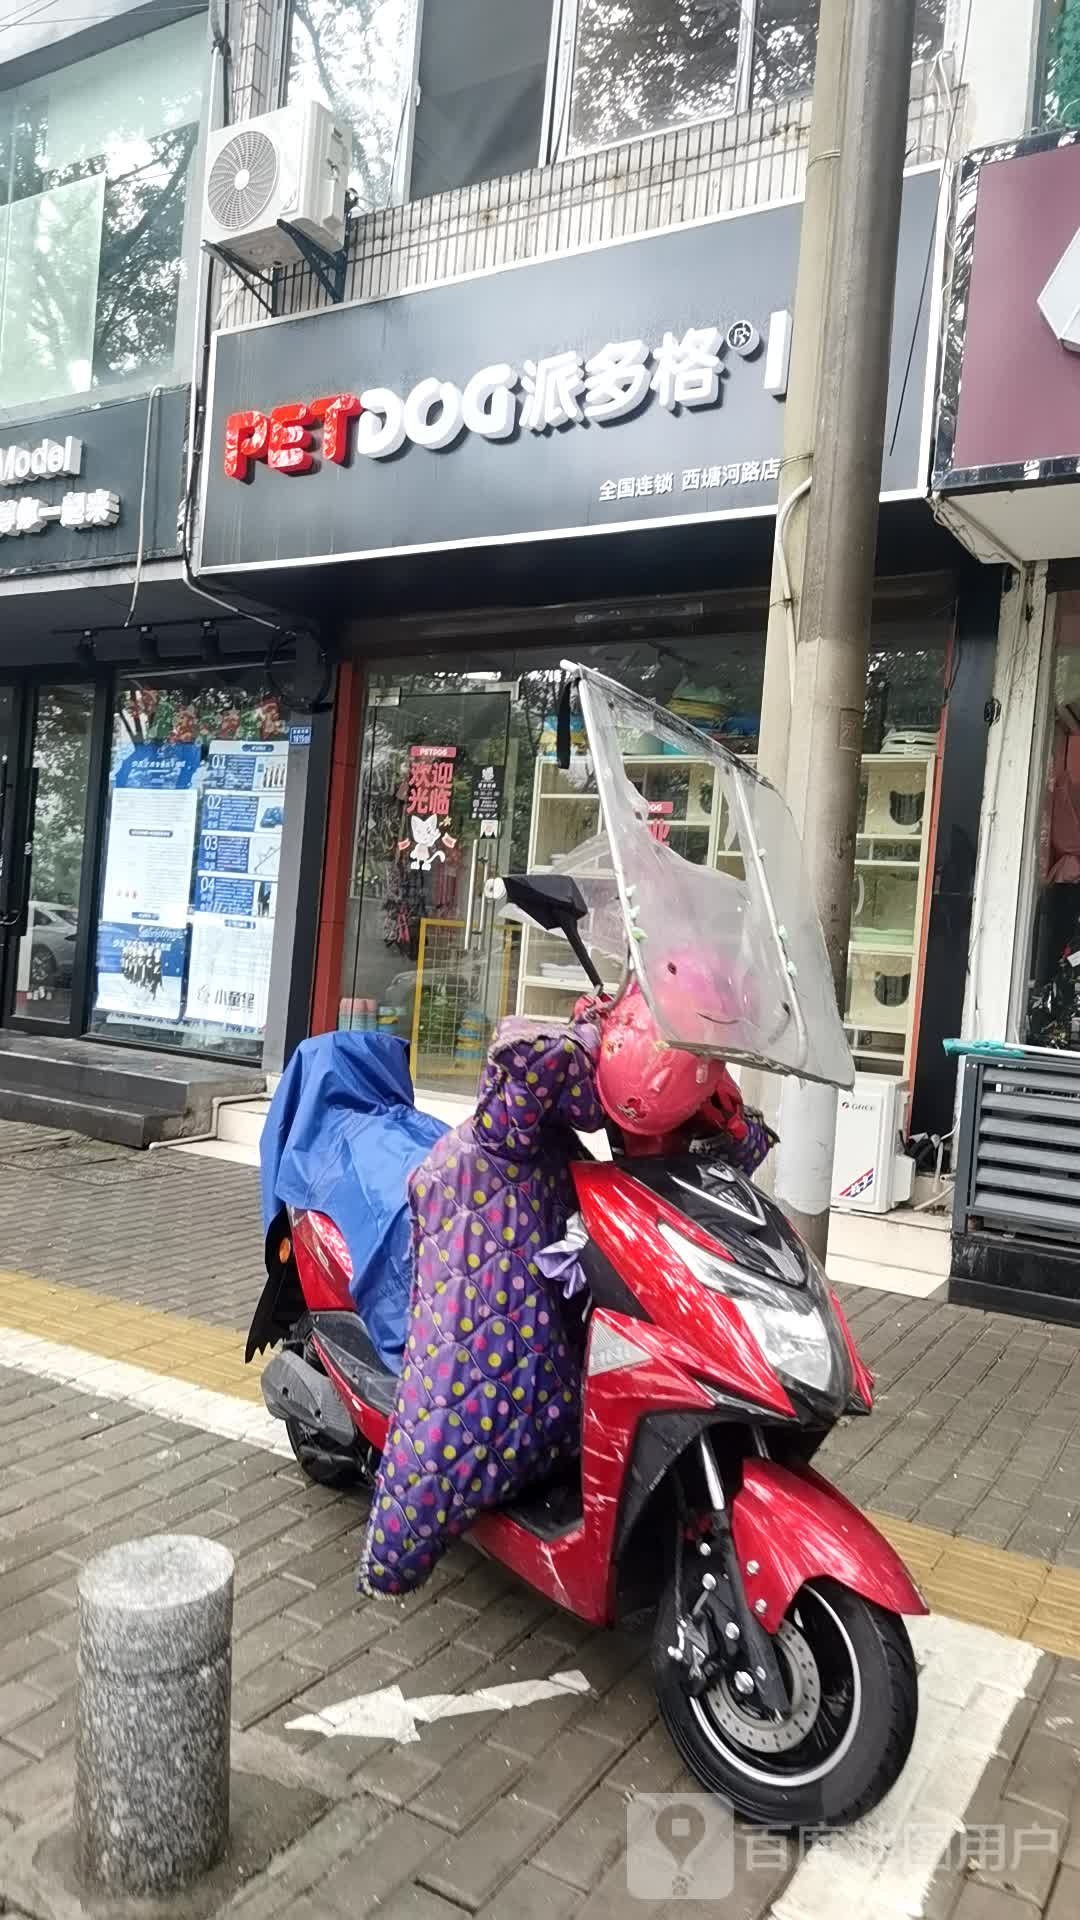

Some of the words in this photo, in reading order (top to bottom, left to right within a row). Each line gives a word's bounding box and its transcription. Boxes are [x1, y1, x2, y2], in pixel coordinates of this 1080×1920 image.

[224, 363, 517, 481] PETDOG
[518, 326, 725, 431] 派多格
[599, 472, 674, 502] 全国连锁
[682, 457, 782, 491] 西塘河路店
[212, 754, 226, 769] 01
[409, 761, 453, 789] 欢迎
[207, 795, 222, 810] 02
[406, 787, 451, 815] 光临
[204, 835, 218, 851] 03
[200, 876, 216, 892] 04
